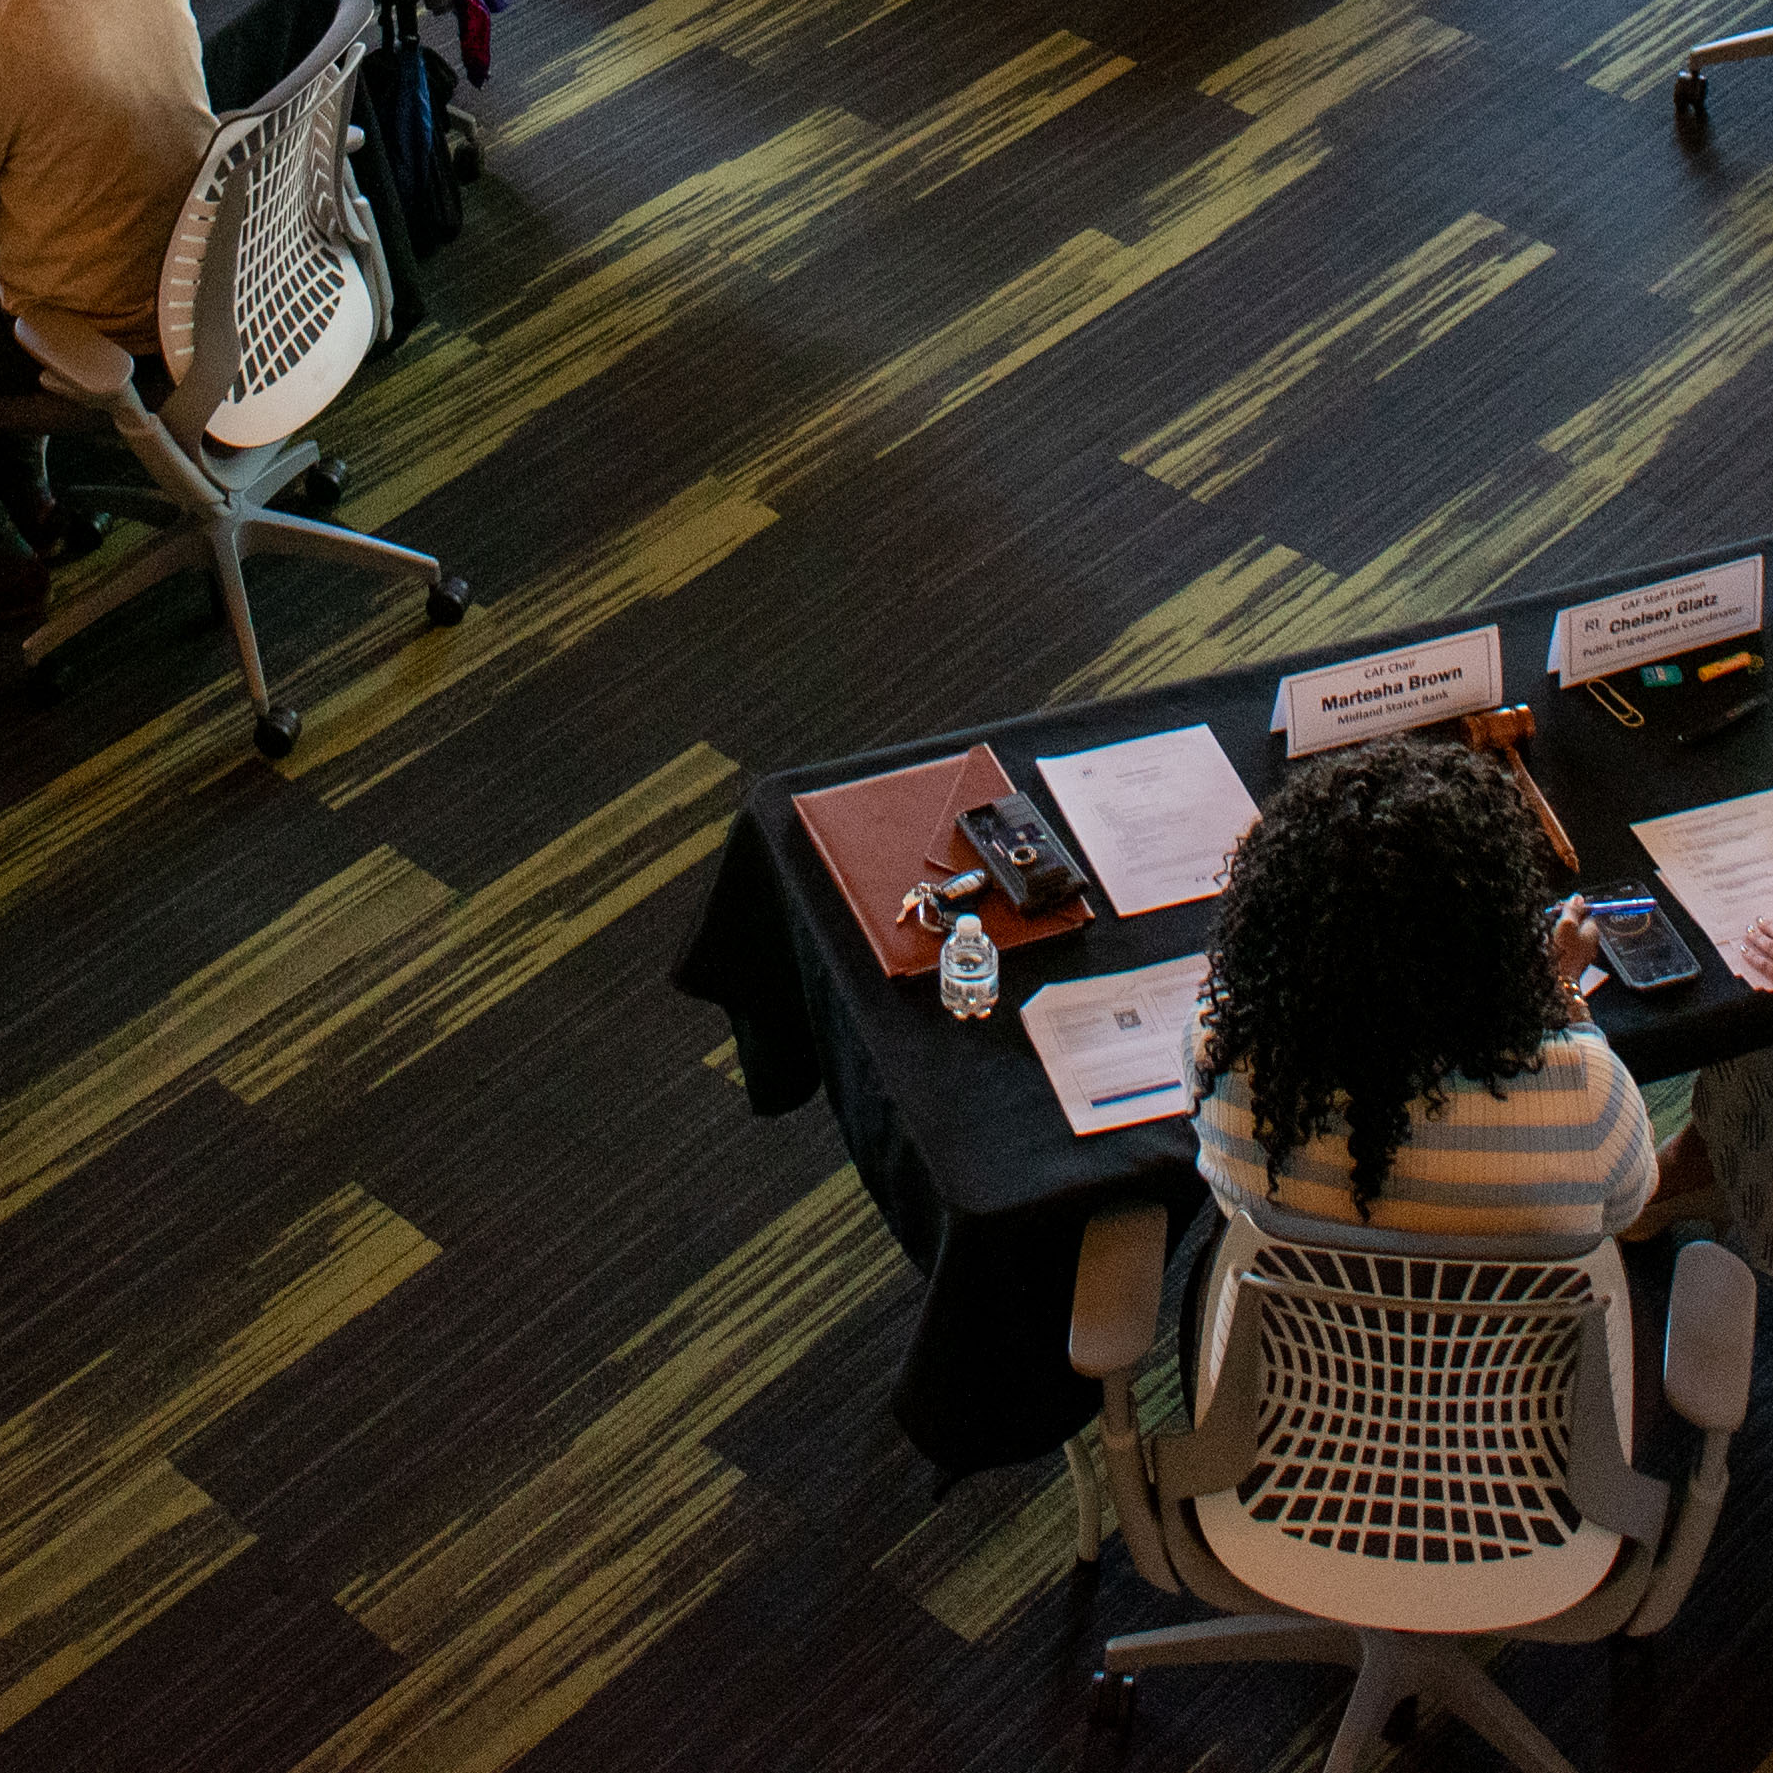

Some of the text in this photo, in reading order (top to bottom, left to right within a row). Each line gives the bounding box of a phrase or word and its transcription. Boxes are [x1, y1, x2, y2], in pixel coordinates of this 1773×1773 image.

[1609, 594, 1718, 634] Chelsey Glatz
[1621, 581, 1706, 611] CAF Staff Liaison
[1583, 605, 1743, 658] Public Engagement Coordinator
[1364, 658, 1417, 680] CAF Chair
[1321, 666, 1463, 712] Martesha Brown
[1337, 689, 1450, 725] Midland States Bank
